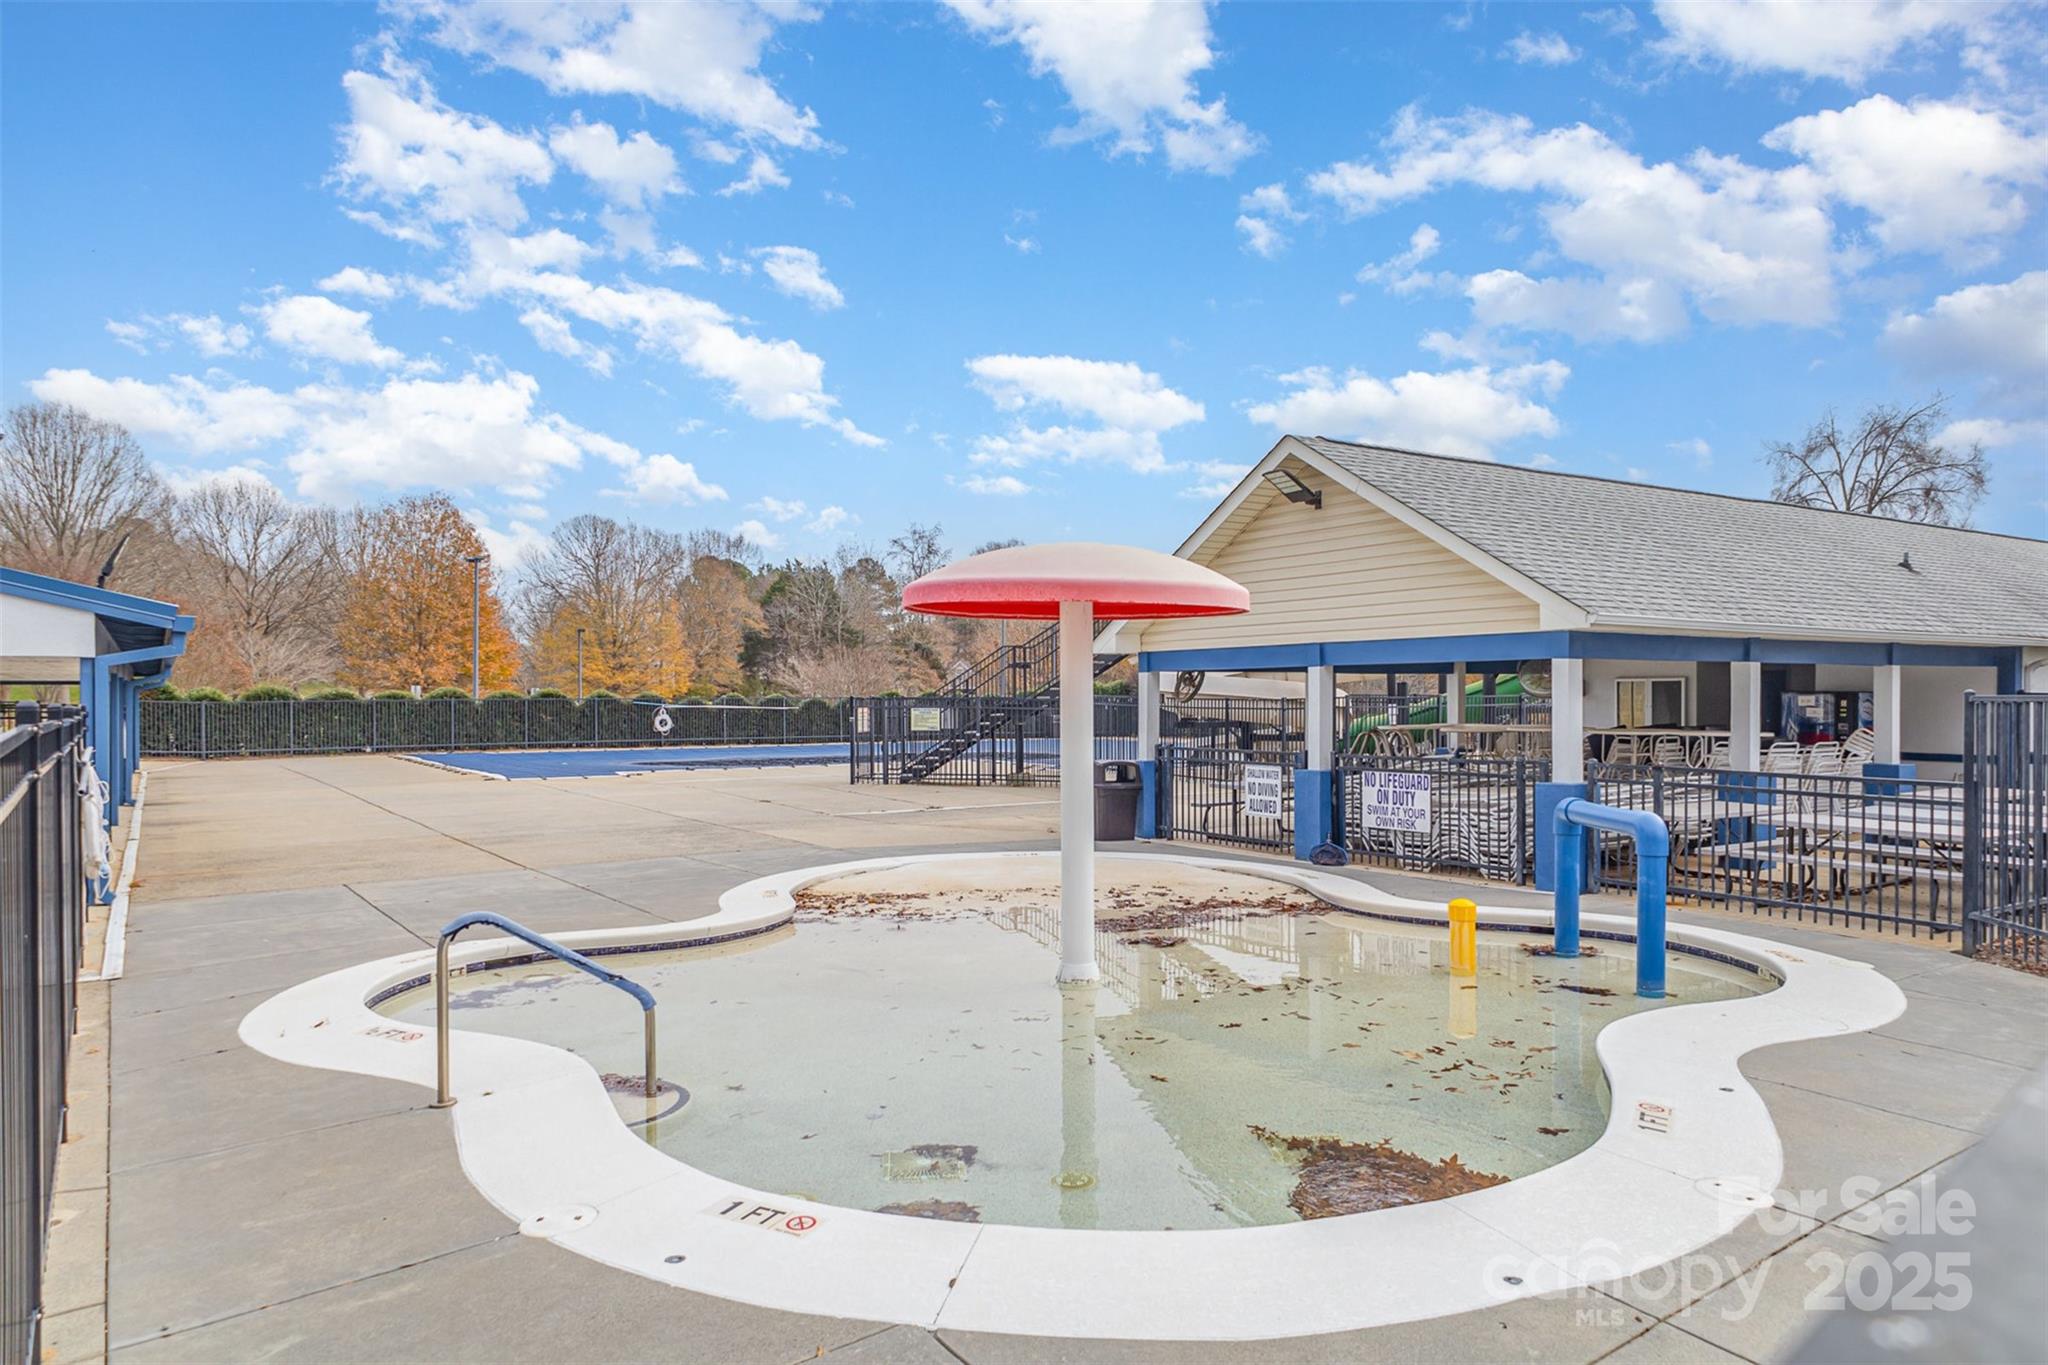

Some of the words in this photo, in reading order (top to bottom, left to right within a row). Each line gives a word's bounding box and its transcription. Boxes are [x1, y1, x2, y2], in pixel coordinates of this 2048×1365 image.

[1248, 782, 1256, 796] NO
[1258, 782, 1279, 797] DIVING
[1364, 772, 1376, 787] NO
[1379, 773, 1429, 791] LIFEGUARD
[1377, 789, 1389, 804] ON
[1392, 790, 1416, 806] DUTY
[1249, 798, 1277, 814] ALLOWED
[1367, 805, 1388, 816] SWIM
[1390, 807, 1401, 817] AT
[1402, 808, 1426, 819] YOUR
[1375, 816, 1395, 828] OWN
[1397, 818, 1416, 830] RISK
[720, 1201, 744, 1215] 1
[740, 1206, 786, 1225] FT
